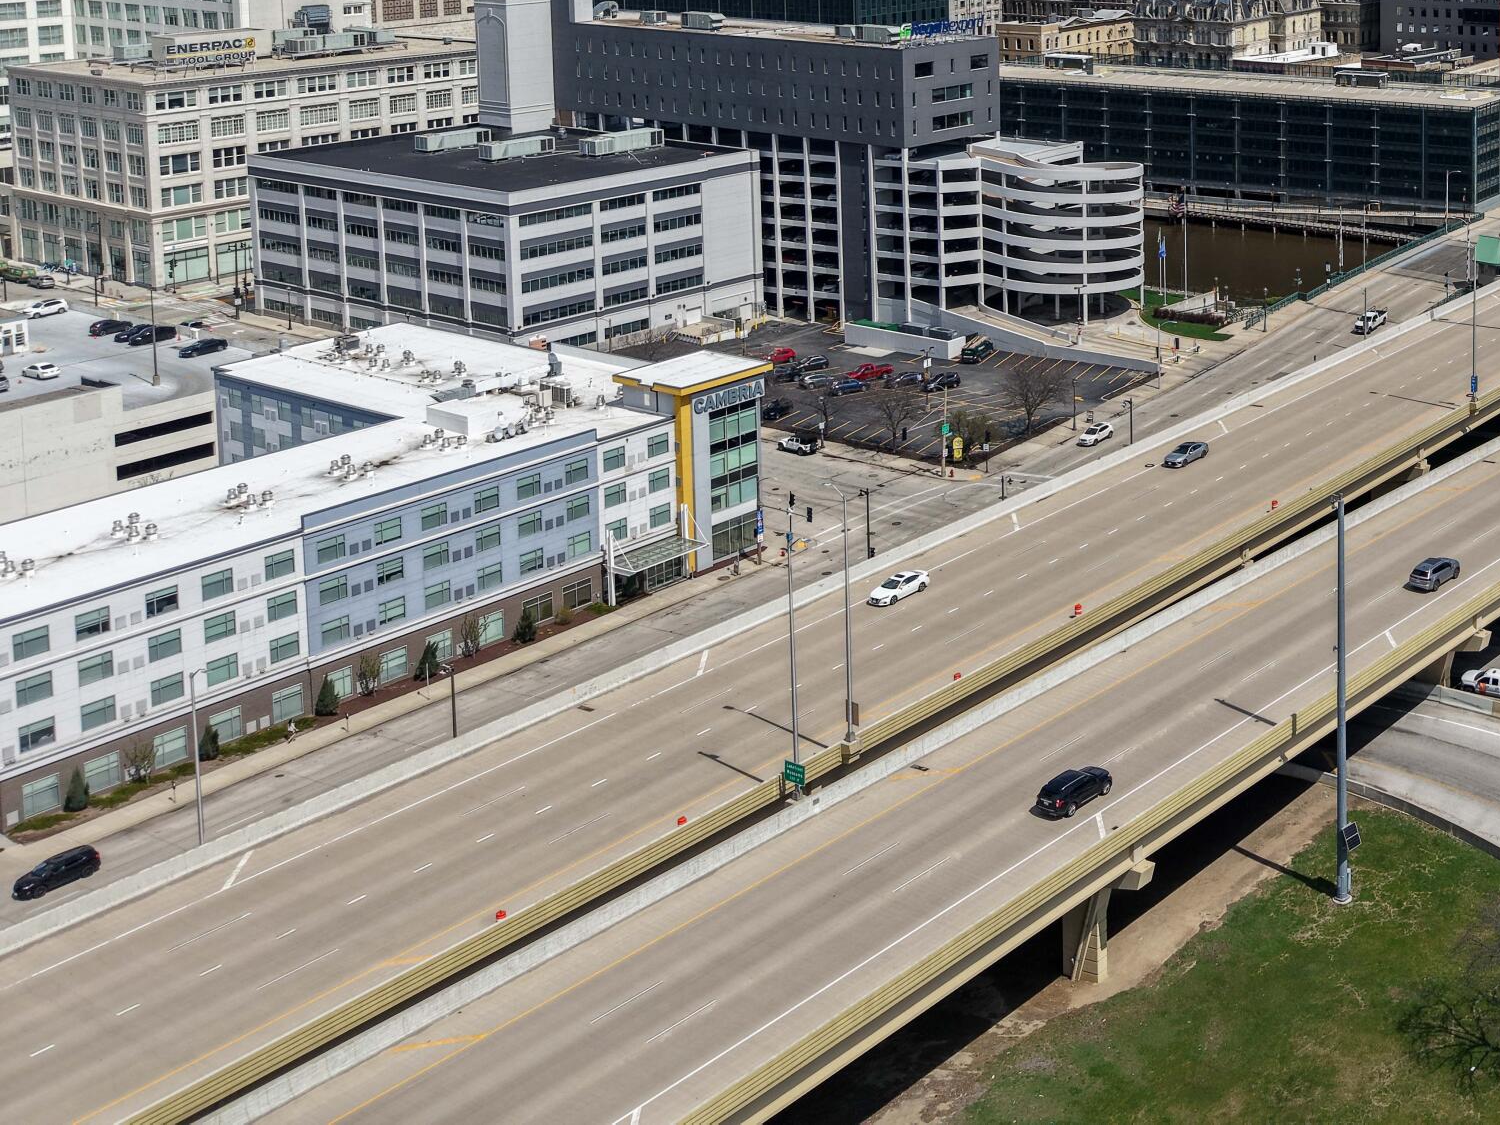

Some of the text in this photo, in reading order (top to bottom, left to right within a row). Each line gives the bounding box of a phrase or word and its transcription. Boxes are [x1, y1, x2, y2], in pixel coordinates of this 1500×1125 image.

[167, 38, 243, 55] ENERPAC
[181, 50, 256, 65] TOOL GROUP
[693, 380, 764, 415] CAMBRIA
